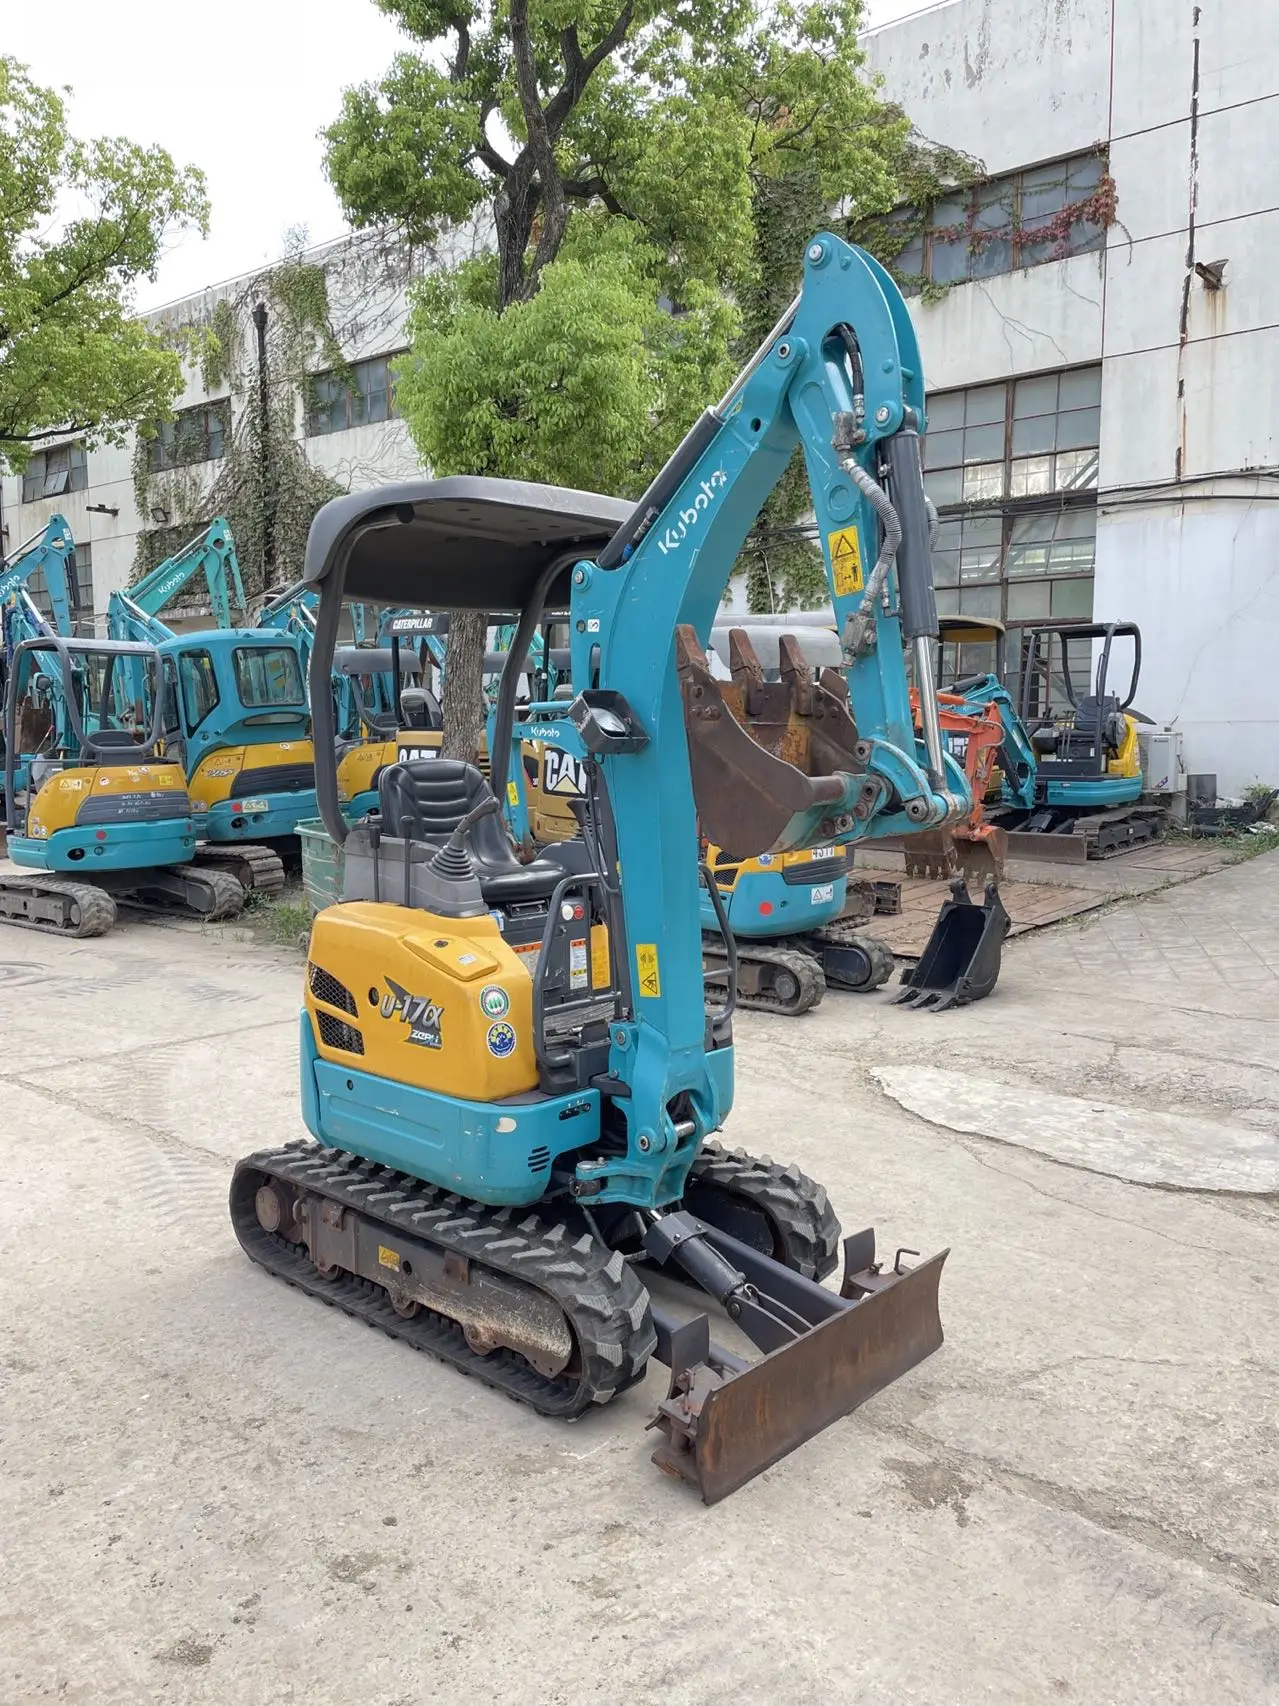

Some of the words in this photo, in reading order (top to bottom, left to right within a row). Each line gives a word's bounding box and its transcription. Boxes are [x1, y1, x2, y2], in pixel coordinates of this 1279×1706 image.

[657, 470, 728, 555] Kubota
[158, 571, 185, 595] Kubota
[392, 617, 433, 630] CATERPILLAR
[531, 726, 561, 738] Kubota
